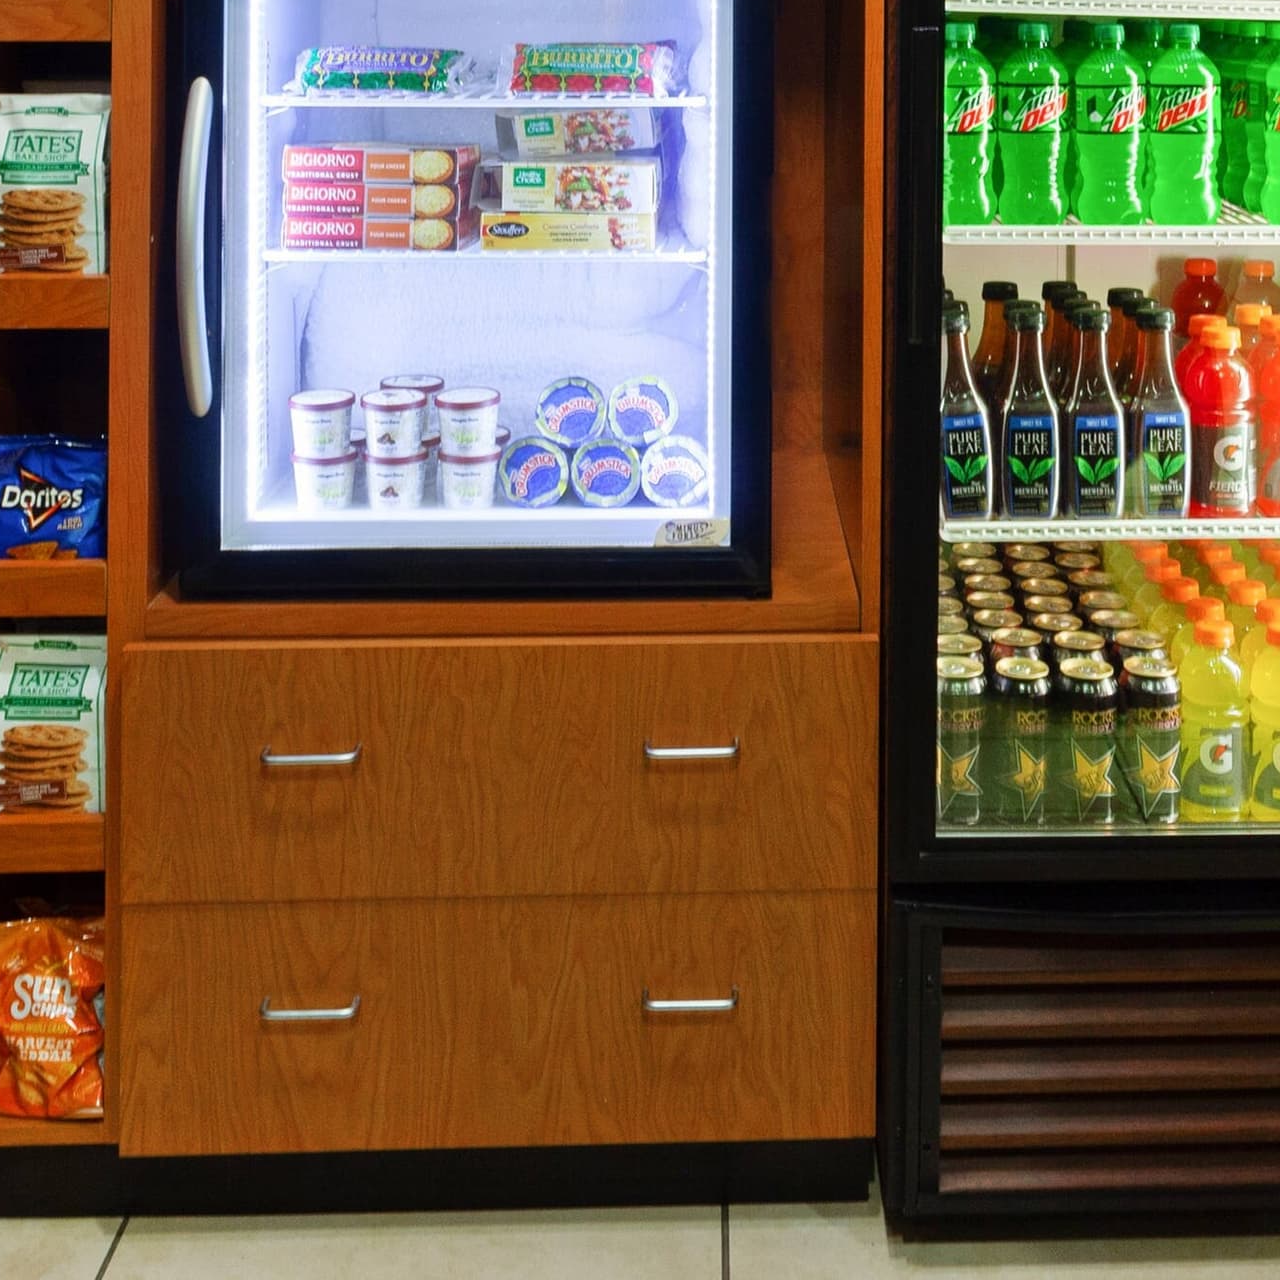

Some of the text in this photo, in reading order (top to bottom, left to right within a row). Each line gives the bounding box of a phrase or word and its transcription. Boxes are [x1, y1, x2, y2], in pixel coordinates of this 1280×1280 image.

[531, 51, 633, 68] BURRITO
[13, 135, 76, 153] TATE'S
[44, 154, 68, 162] SHOP
[290, 152, 356, 167] DIGIORNO
[291, 187, 357, 201] DIGIORNO
[290, 222, 355, 236] DIGIORNO
[548, 396, 597, 433] DRUMSTICK
[949, 430, 981, 444] PURE
[1014, 431, 1048, 444] PURE
[1081, 431, 1114, 445] PURE
[1149, 428, 1182, 441] PURE
[949, 442, 983, 456] LEAF
[1014, 442, 1049, 456] LEAF
[1081, 442, 1115, 457] LEAF
[1149, 439, 1183, 453] LEAF
[515, 453, 556, 497] DRUMSTICK
[581, 458, 632, 487] DRUMSTICK
[1208, 480, 1247, 493] FIERC
[0, 485, 84, 509] Doritos
[18, 669, 81, 688] TATE'S
[47, 687, 70, 696] SHOP
[1199, 732, 1233, 775] G
[10, 973, 79, 1020] Sun
